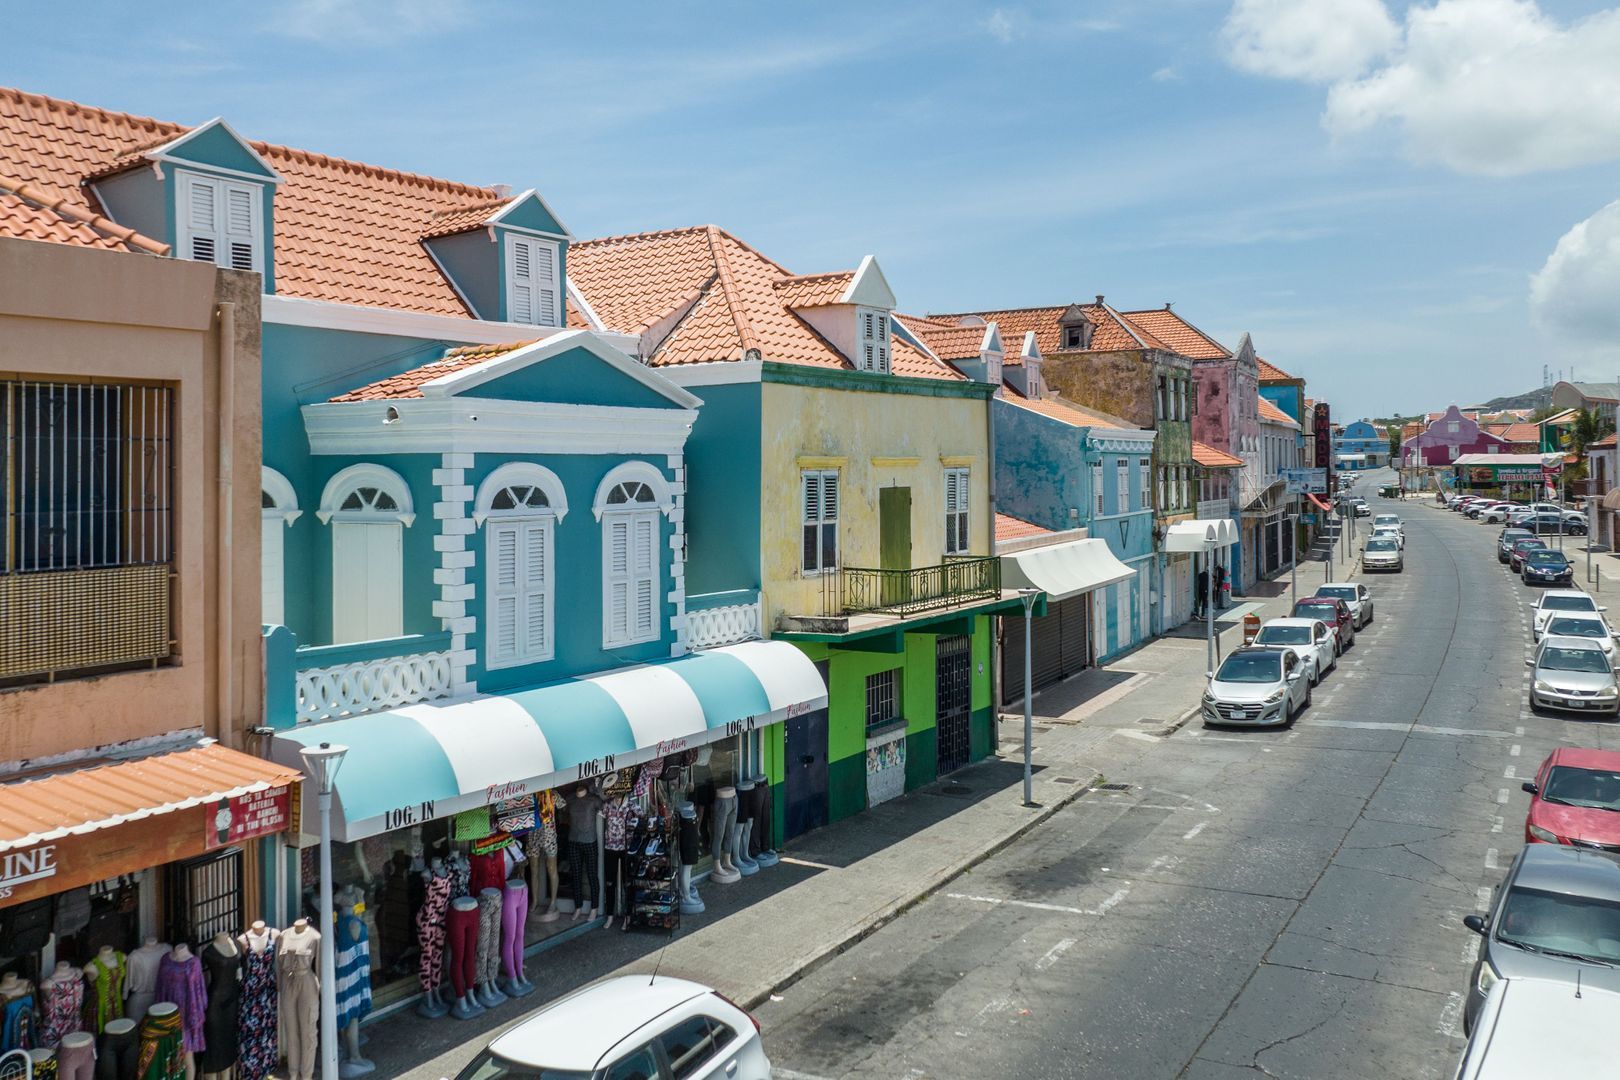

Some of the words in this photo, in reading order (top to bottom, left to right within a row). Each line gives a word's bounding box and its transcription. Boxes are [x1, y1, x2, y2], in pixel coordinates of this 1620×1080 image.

[786, 702, 811, 719] Fashion
[726, 719, 744, 736] LOG.
[747, 715, 755, 731] IN
[656, 738, 687, 758] Fashion
[578, 759, 601, 779] LOG.
[605, 753, 615, 771] IN
[487, 781, 527, 803] Fashion
[385, 806, 416, 830] LOG.
[421, 800, 434, 820] IN
[0, 844, 57, 880] INE
